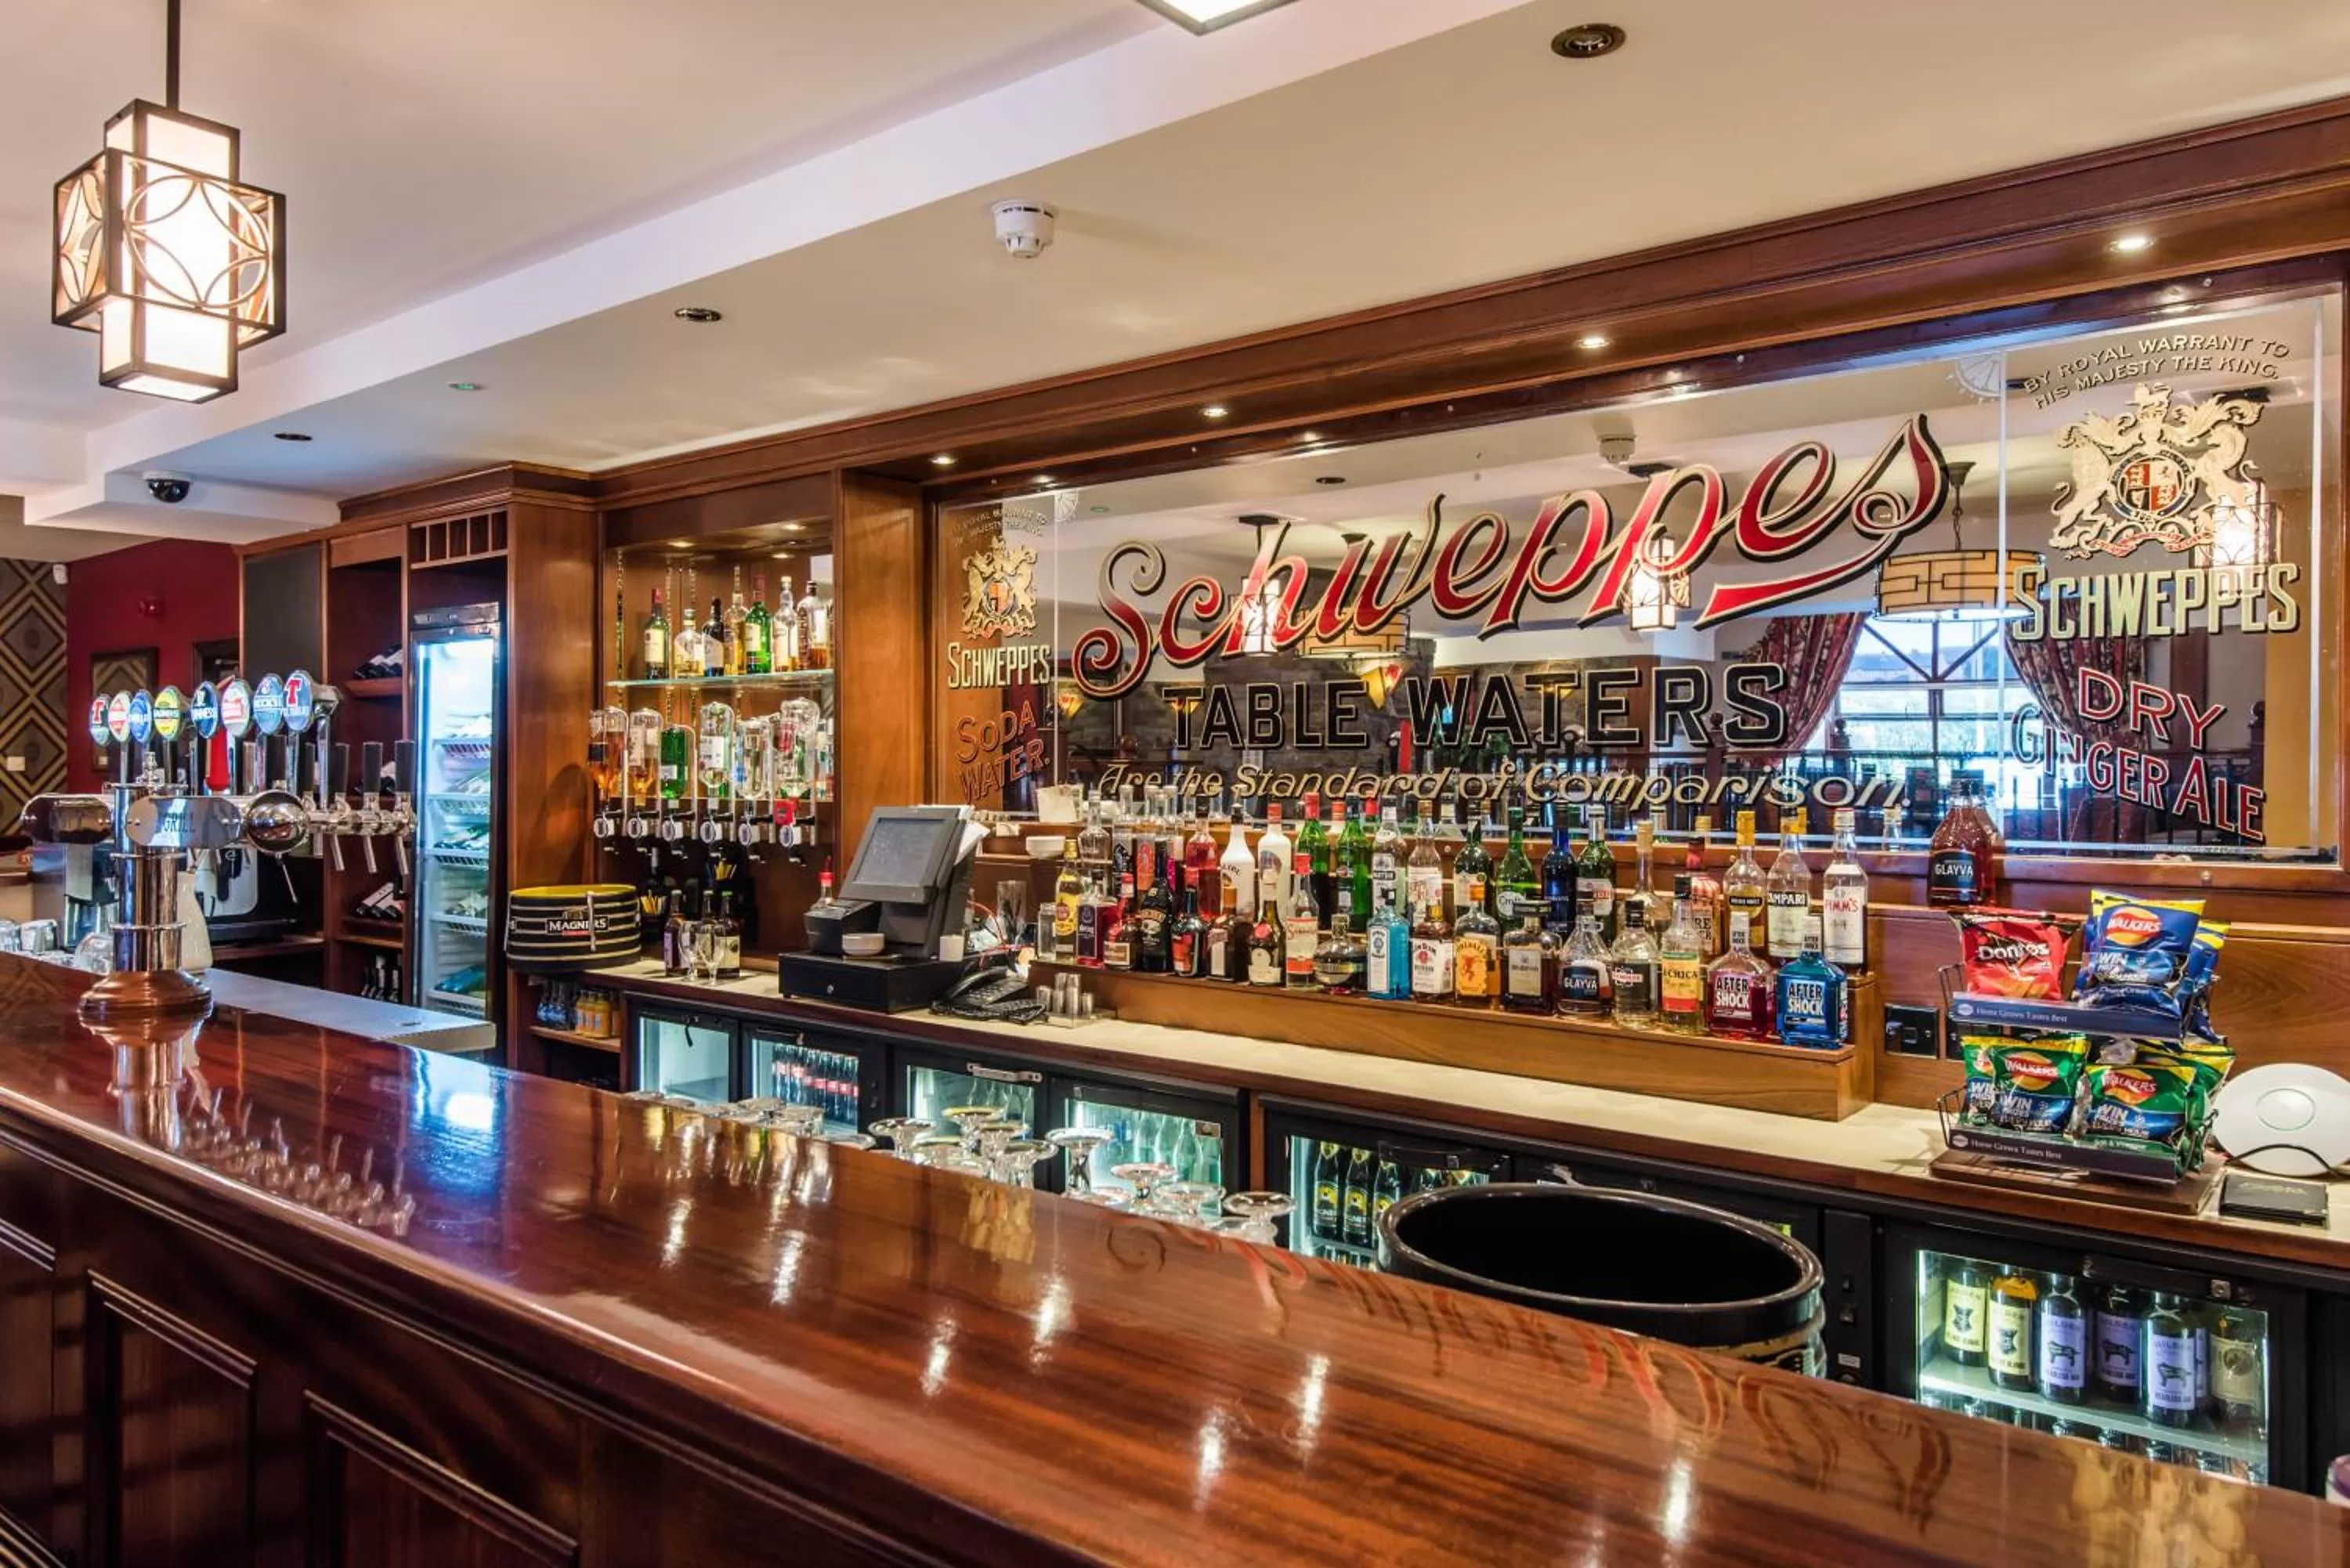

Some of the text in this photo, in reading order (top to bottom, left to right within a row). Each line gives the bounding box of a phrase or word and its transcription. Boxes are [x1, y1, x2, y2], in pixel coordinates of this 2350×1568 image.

[2023, 334, 2290, 393] BY ROYAL WARRANT TO
[2034, 385, 2071, 410] HIS
[2076, 358, 2167, 391] MAJESTY
[2171, 356, 2213, 371] THE
[1071, 414, 1950, 702] Schweppes
[2012, 562, 2302, 642] SCHWEPPES
[947, 641, 1051, 689] SCHWEPPES
[1162, 662, 1788, 750] TABLE WATERS
[2077, 666, 2229, 752] DRY
[955, 699, 1037, 764] SODA
[1098, 759, 1162, 794] Are
[1173, 765, 1224, 797] the
[1231, 764, 1452, 800] Standard
[1459, 762, 1517, 801] of
[2011, 703, 2267, 842] GINGER ALE
[1934, 864, 1973, 877] GLAYVA
[1769, 891, 1806, 905] AMPARI
[2107, 918, 2163, 932] WALKERS
[1976, 942, 2050, 961] Doritos
[2098, 952, 2127, 966] WIN
[1564, 977, 1599, 990] GLAYVA
[1716, 977, 1749, 992] AFTER
[1788, 983, 1823, 1001] AFTER
[1716, 992, 1750, 1010] SHOCK
[1788, 998, 1824, 1016] SHOCK
[2005, 1058, 2059, 1076] WALKERS
